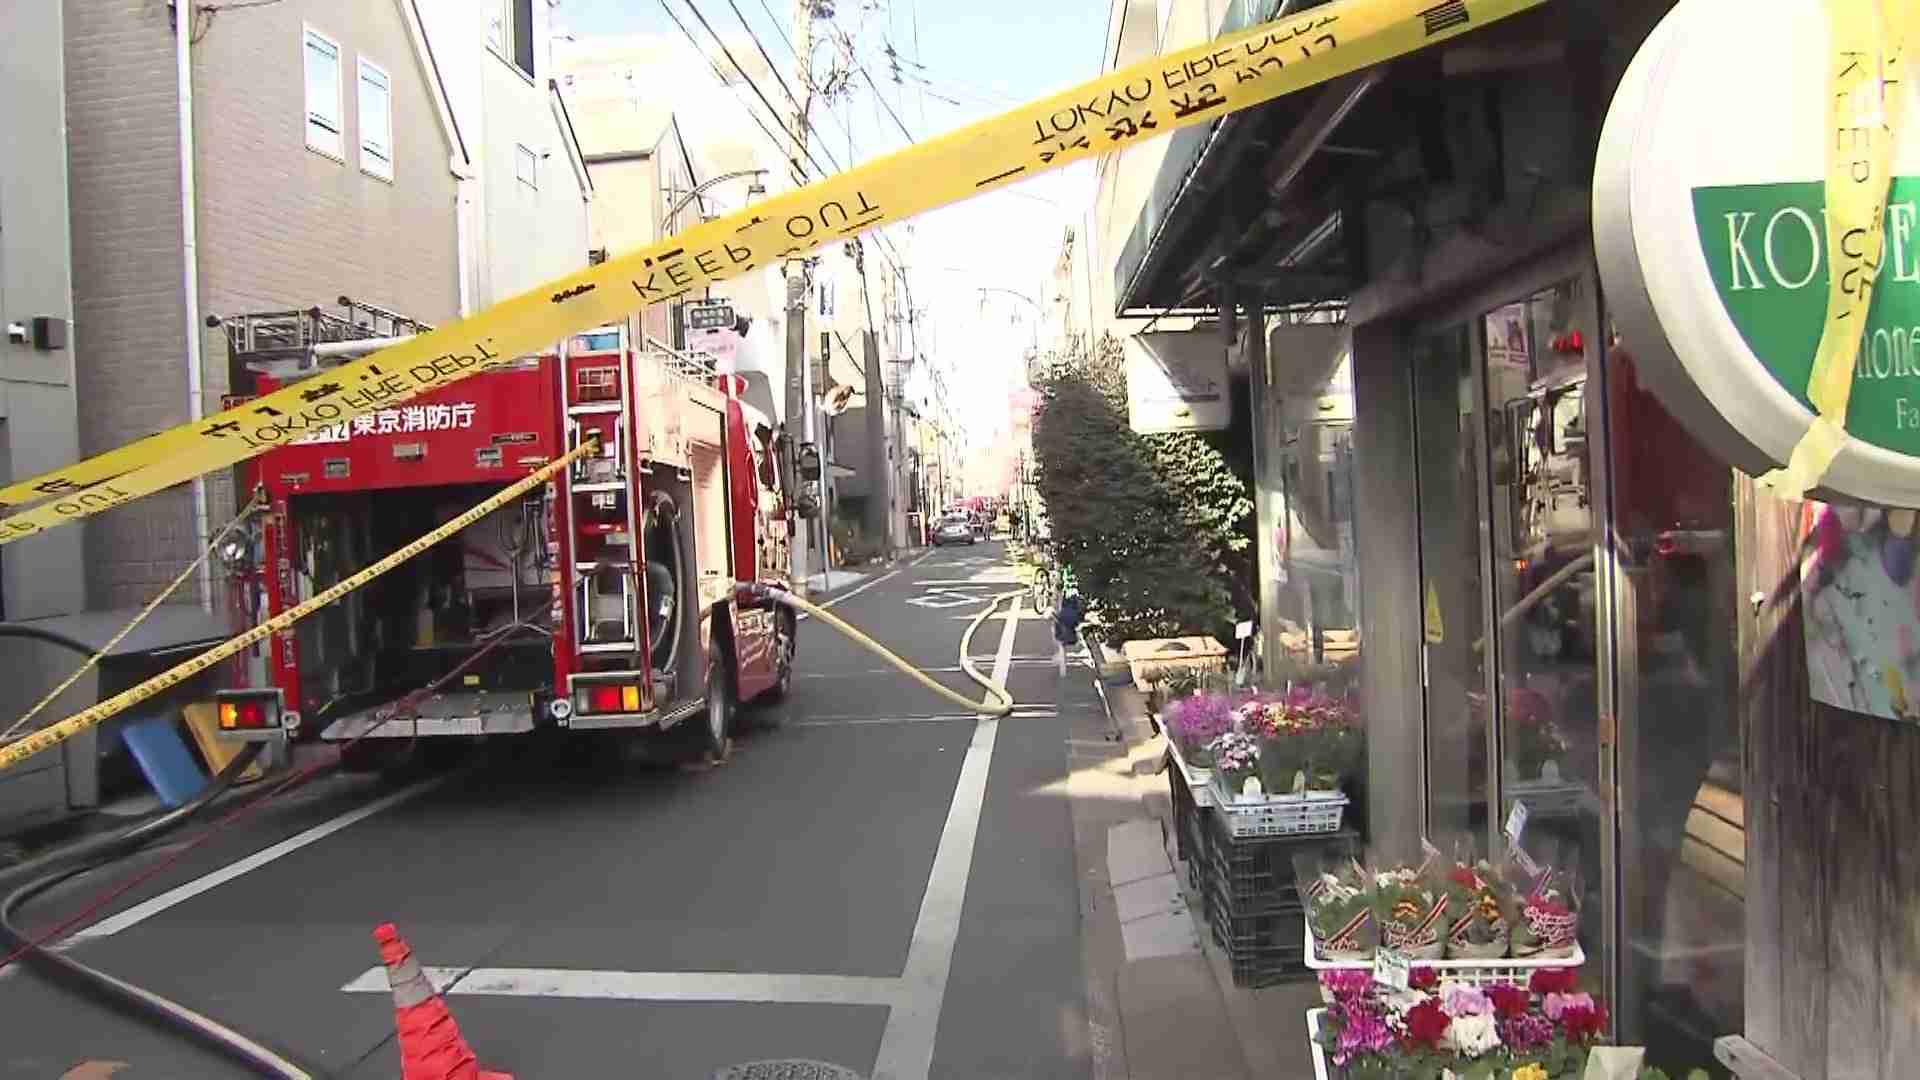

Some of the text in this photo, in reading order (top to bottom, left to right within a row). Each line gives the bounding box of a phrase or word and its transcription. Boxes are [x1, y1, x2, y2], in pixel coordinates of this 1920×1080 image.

[352, 402, 477, 436] 東京消防庁
